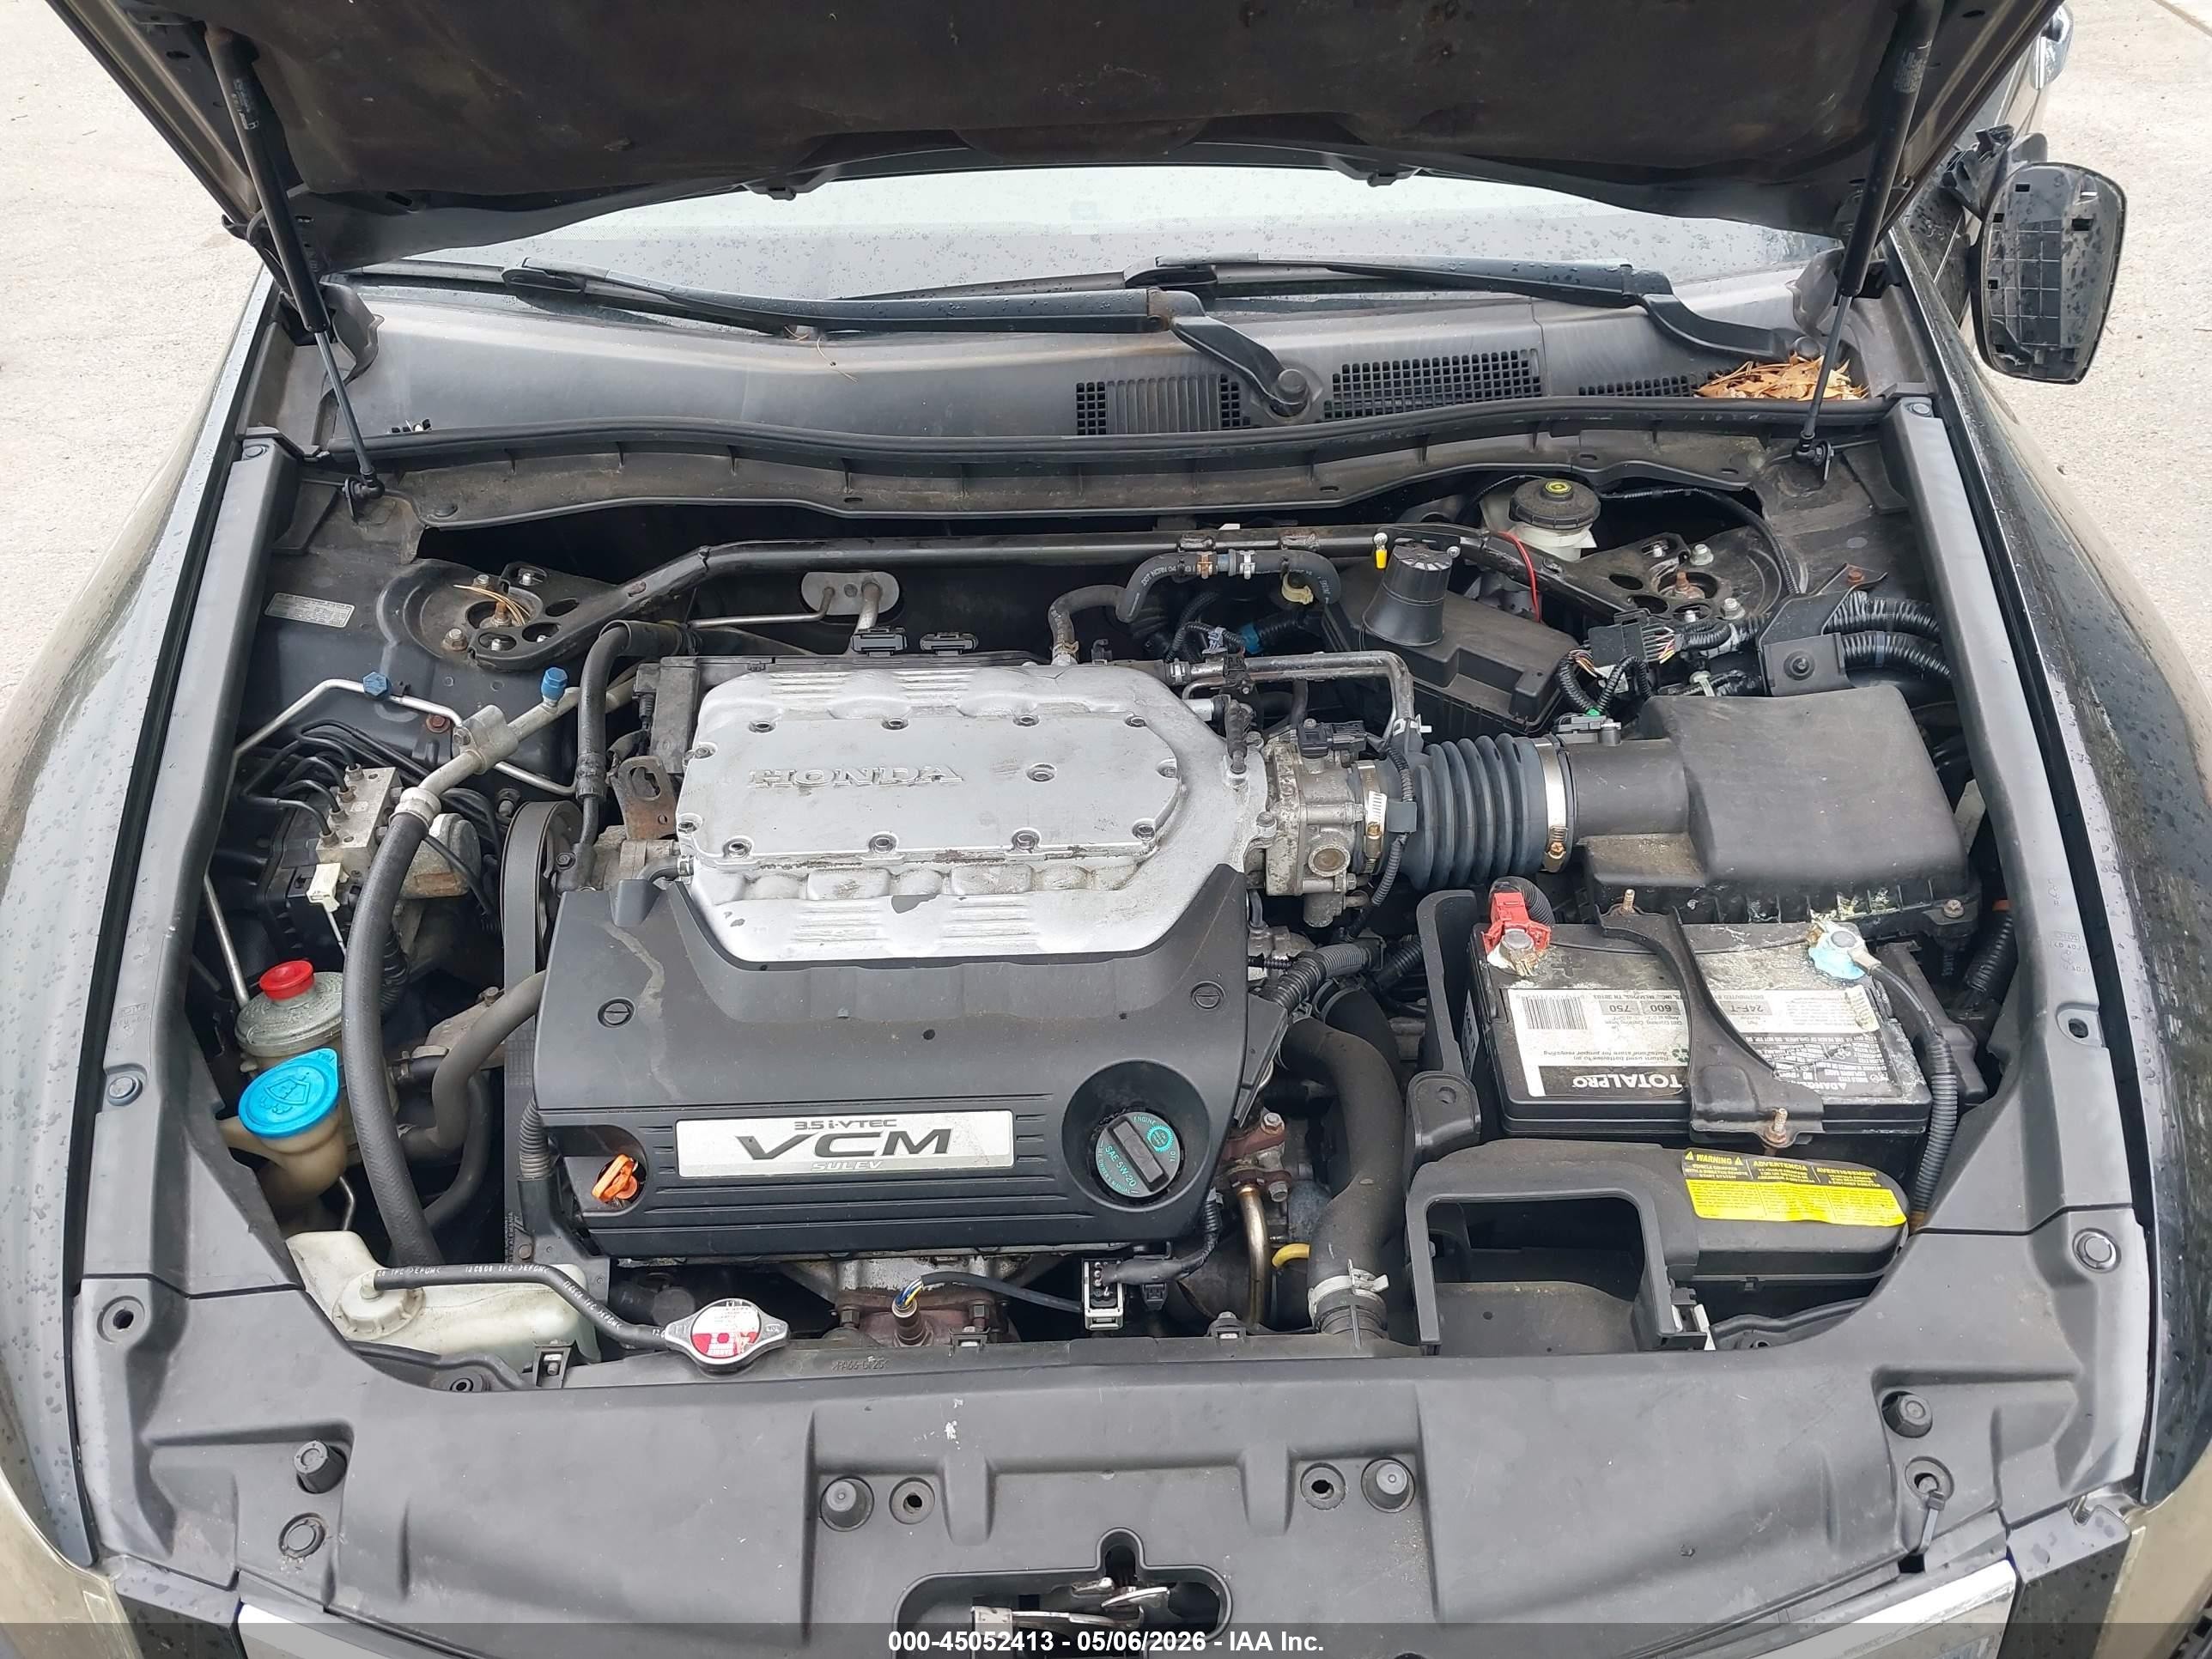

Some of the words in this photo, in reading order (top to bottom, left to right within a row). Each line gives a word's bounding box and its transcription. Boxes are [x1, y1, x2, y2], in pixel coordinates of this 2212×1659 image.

[748, 763, 963, 787] HONDA
[1731, 1004, 1764, 1012] 24F-T
[1573, 1073, 1683, 1089] TOTALPRO
[793, 1121, 825, 1131] 3.5
[828, 1119, 897, 1129] i-VTEC
[734, 1127, 953, 1161] VCM
[1696, 1153, 1733, 1165] WARNING
[810, 1160, 883, 1171] SULEV
[1105, 1146, 1120, 1162] SAE
[1115, 1161, 1137, 1187] 5W-20
[1753, 1160, 1808, 1171] ADVERTENCIA
